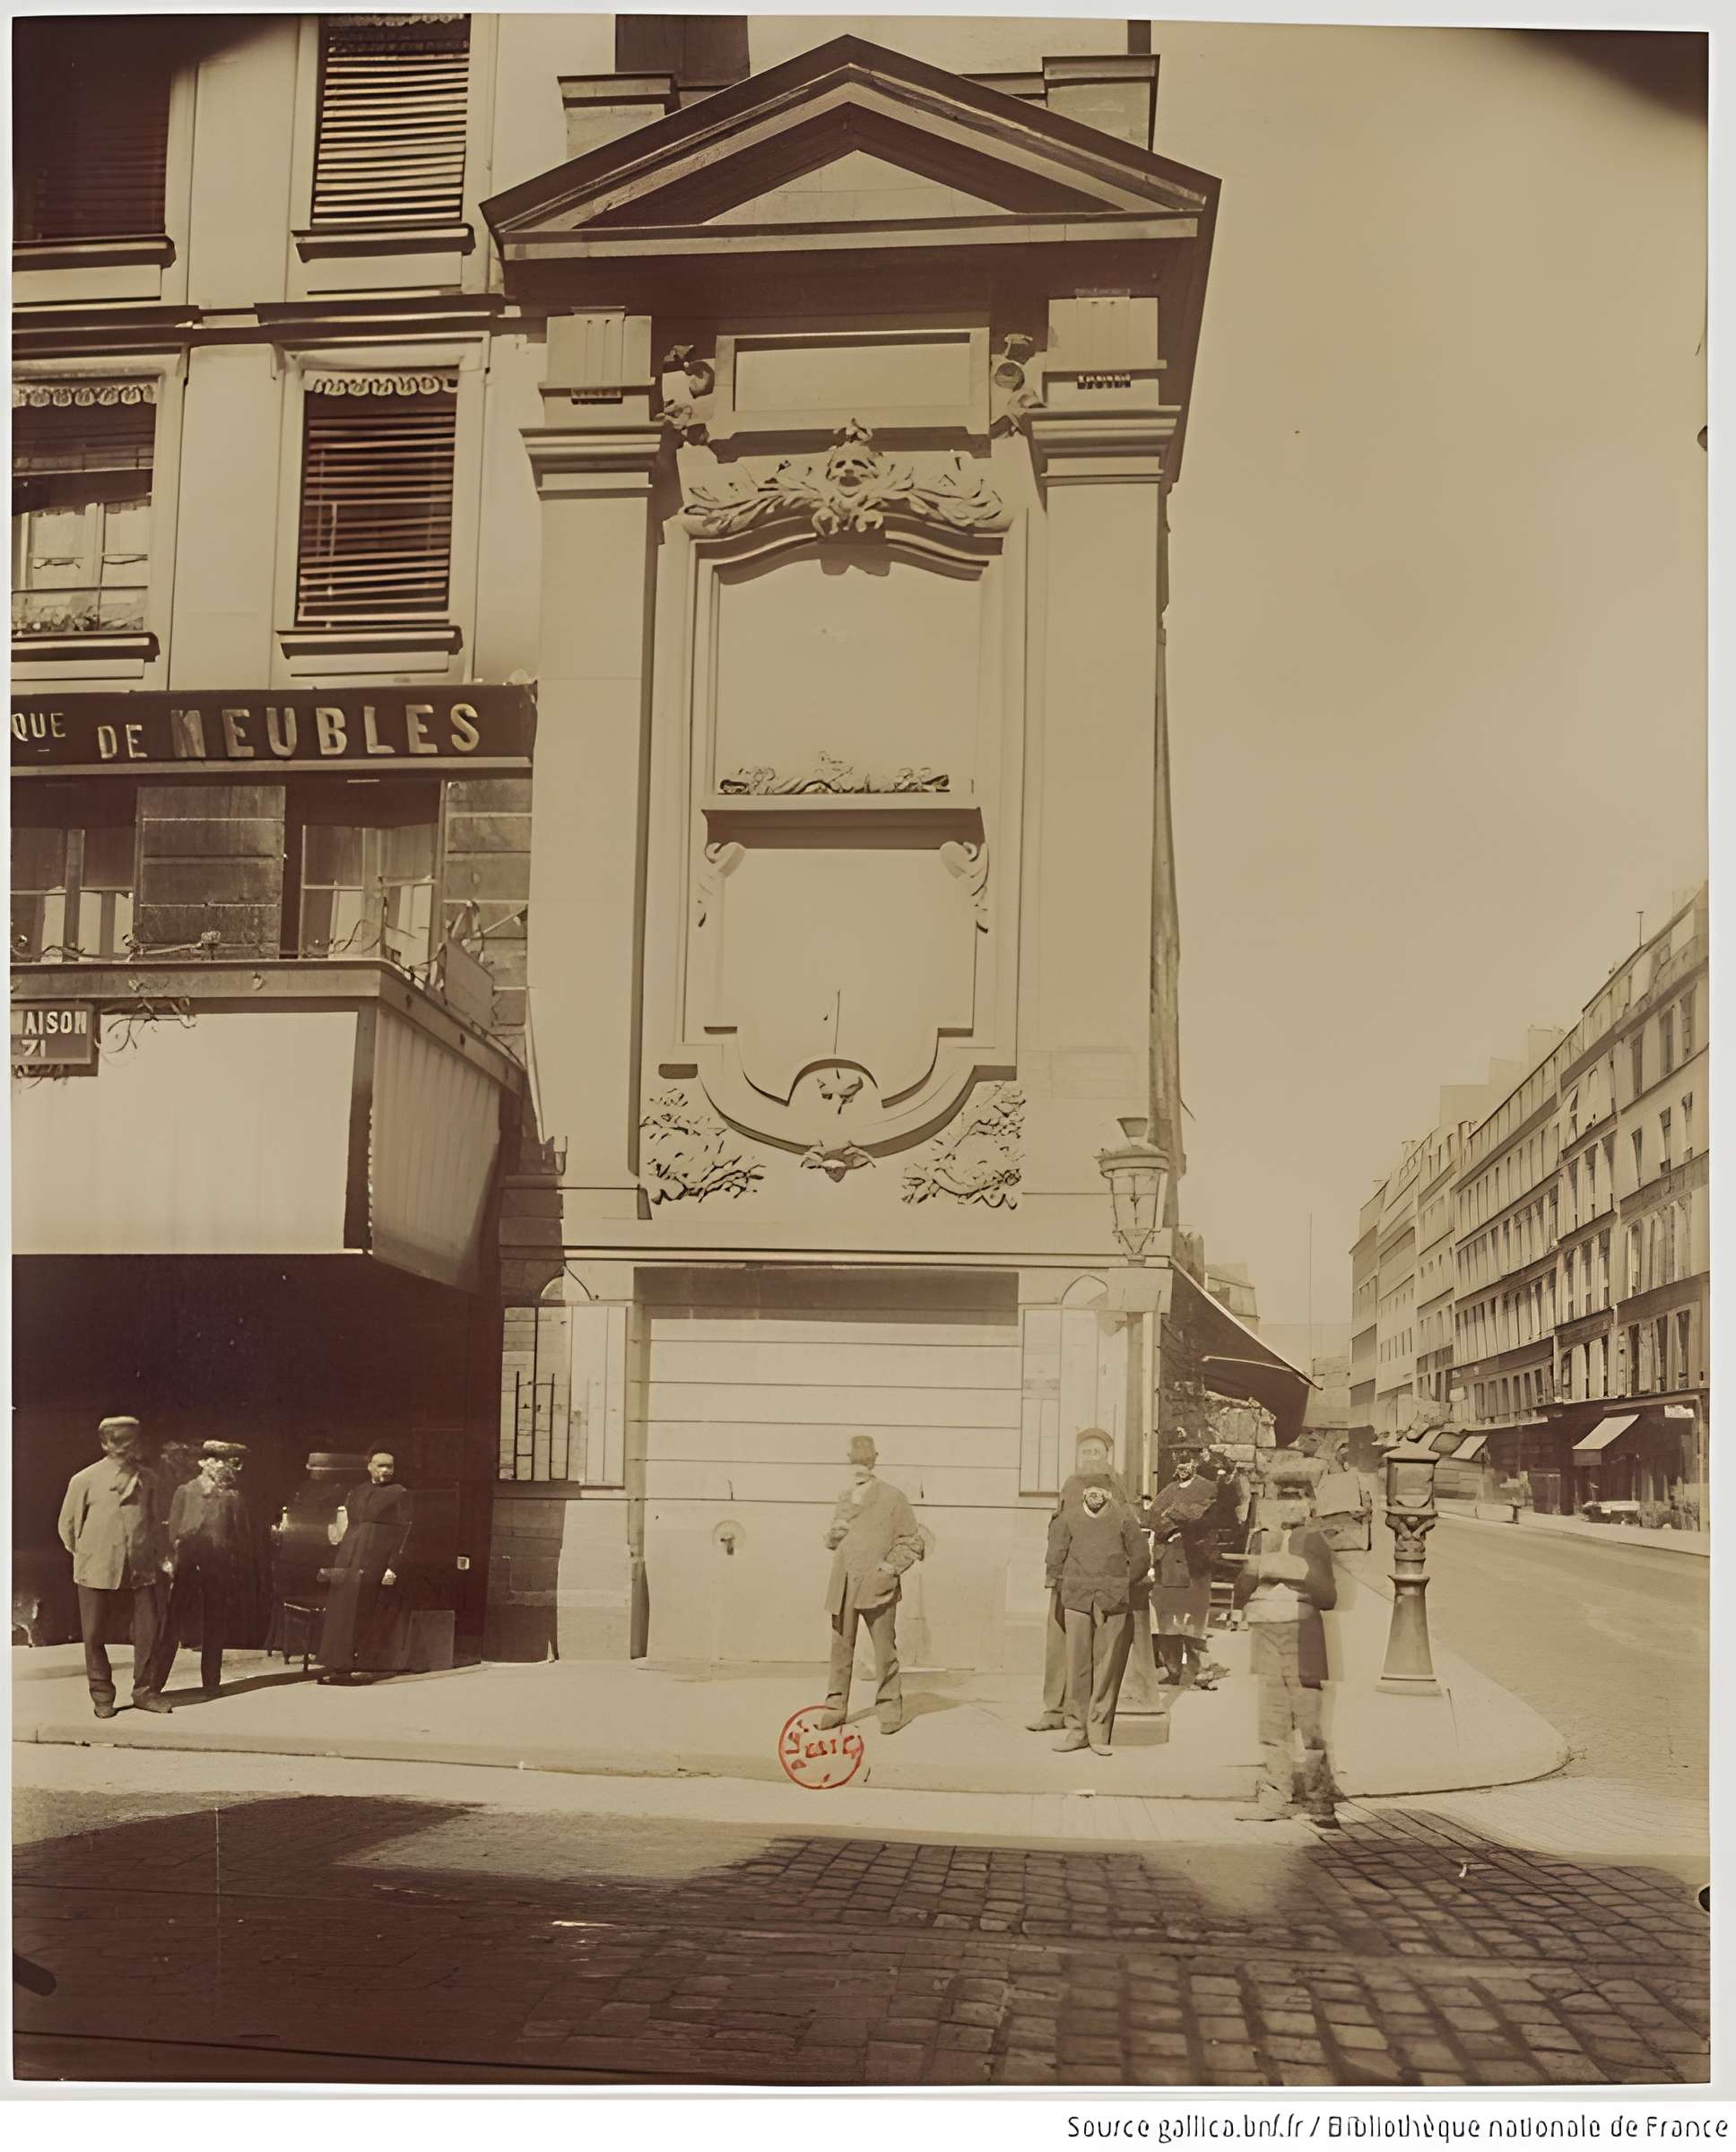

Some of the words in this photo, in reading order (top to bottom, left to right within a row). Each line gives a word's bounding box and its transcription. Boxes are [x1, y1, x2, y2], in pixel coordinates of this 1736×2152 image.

[12, 712, 65, 742] QUE
[97, 724, 148, 759] DE
[170, 703, 480, 759] MEUBLES
[11, 1011, 87, 1035] AISON
